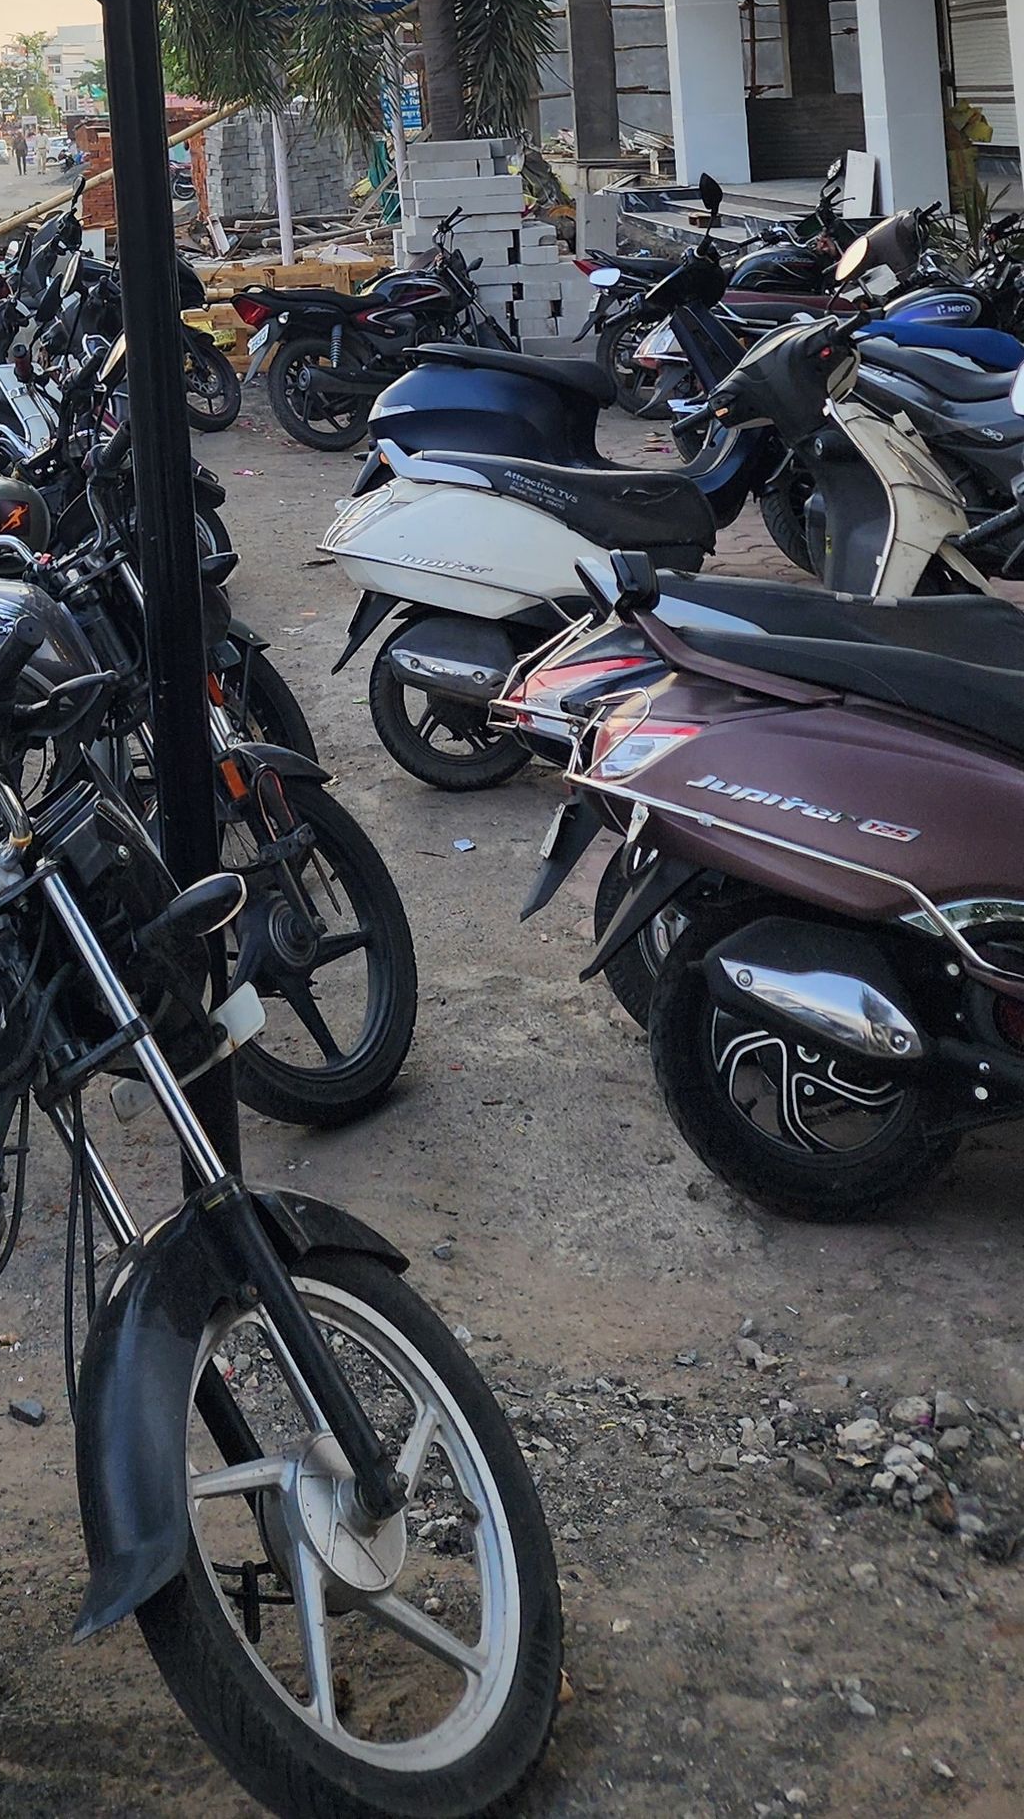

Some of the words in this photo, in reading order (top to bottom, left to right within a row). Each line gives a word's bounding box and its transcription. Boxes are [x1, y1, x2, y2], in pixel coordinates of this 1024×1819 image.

[504, 469, 556, 494] Attractive
[558, 489, 578, 503] TVS
[865, 821, 913, 840] 125
